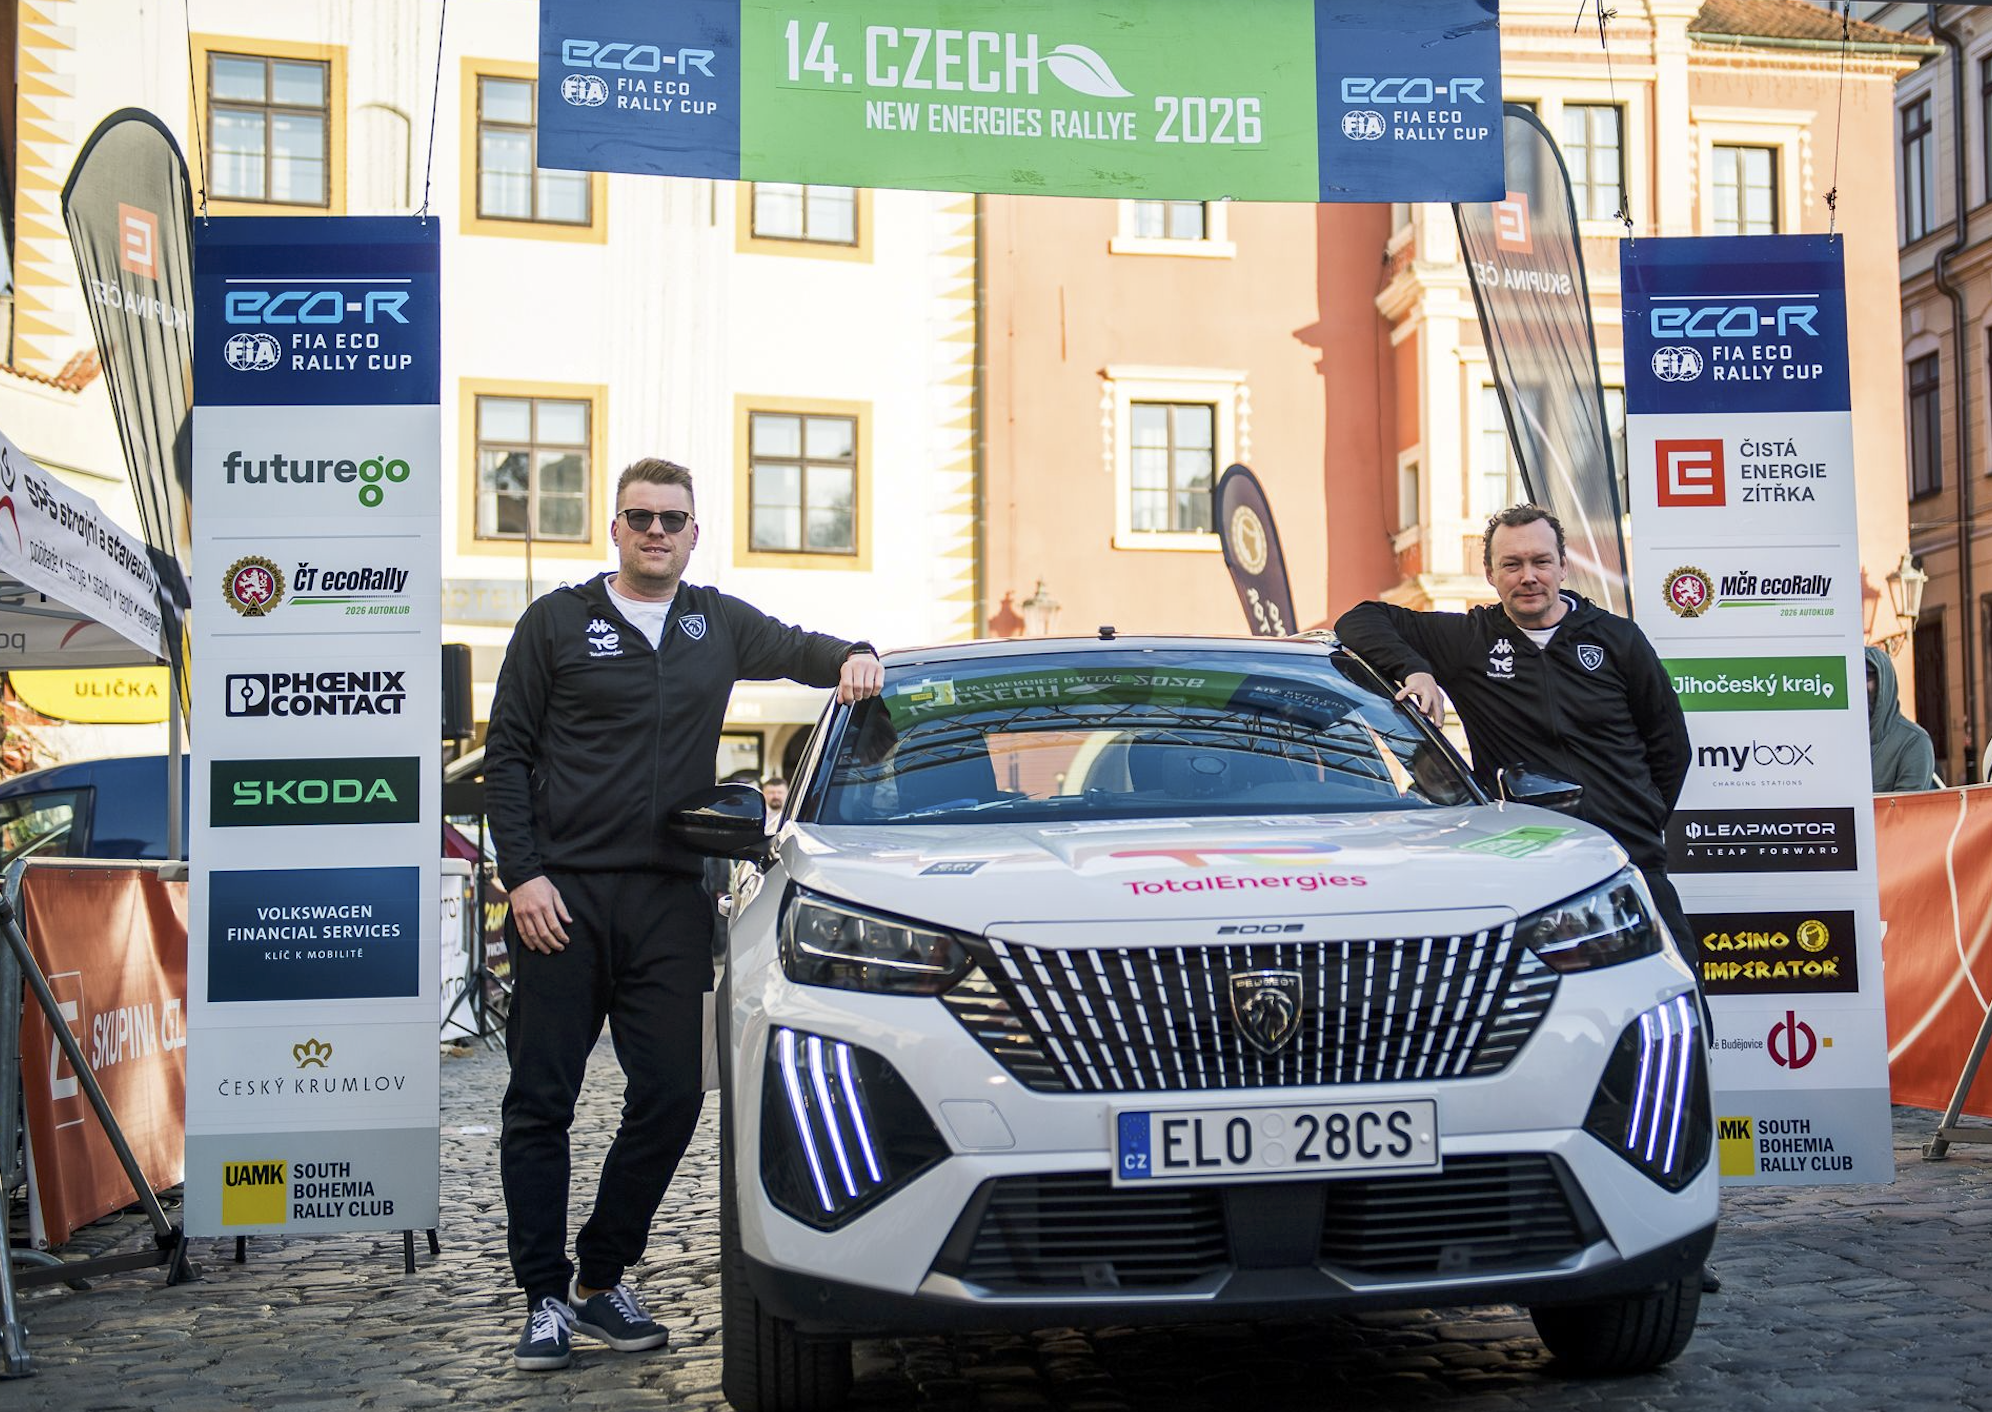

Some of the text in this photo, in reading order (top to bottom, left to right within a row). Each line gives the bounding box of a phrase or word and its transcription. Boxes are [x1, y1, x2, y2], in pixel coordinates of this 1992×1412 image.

[785, 19, 1039, 94] 14. CZECH
[617, 77, 690, 96] FIA ECO
[617, 95, 717, 115] RALLY CUP
[866, 95, 1262, 144] NEW ENERGIES RALLYE 2026
[1393, 110, 1462, 124] FIA ECO
[1393, 127, 1488, 141] RALLY CUP
[292, 333, 379, 349] FIA ECO
[1713, 345, 1792, 361] FIA ECO
[292, 354, 412, 371] RALLY CUP
[1713, 364, 1823, 381] RALLY CUP
[1740, 438, 1797, 457] ČISTÁ
[223, 451, 410, 508] futurego
[1741, 463, 1827, 479] ENERGIE
[1742, 484, 1815, 502] ZÍTŘKA
[99, 528, 106, 551] a
[294, 562, 409, 593] ČT ecoRally
[1720, 570, 1832, 597] MČR ecoRally
[345, 605, 410, 615] 2026 AUTOKLUB
[1780, 607, 1834, 617] 2026 AUTOKLUB
[75, 678, 158, 697] ULIČKA
[1672, 673, 1822, 696] Jihočeský kraj
[271, 693, 406, 717] CONTACT
[1698, 740, 1814, 772] mybox
[1761, 779, 1803, 787] STATIONS
[1704, 822, 1836, 837] LEAPMOTOR
[1707, 848, 1747, 856] LEAP
[1759, 846, 1839, 855] FORWARD
[1123, 872, 1367, 897] TotalEnergies
[257, 905, 372, 921] VOLKSWAGEN
[227, 923, 401, 941] FINANCIAL SERVICES
[1702, 931, 1790, 951] CASINO
[265, 949, 290, 960] KLÍČ
[295, 951, 302, 960] K
[92, 1003, 157, 1071] SKUPINA
[1721, 1038, 1764, 1051] Budějovice
[218, 1075, 406, 1096] ČESKÝ KRUMLOV
[1758, 1119, 1810, 1134] SOUTH
[1294, 1110, 1412, 1163] 28CS
[1760, 1138, 1834, 1153] BOHEMIA
[1124, 1153, 1147, 1170] CZ
[1761, 1156, 1853, 1172] RALLY CLUB
[225, 1162, 350, 1187] UAMK SOUTH
[293, 1181, 375, 1199] BOHEMIA
[293, 1200, 394, 1219] RALLY CLUB
